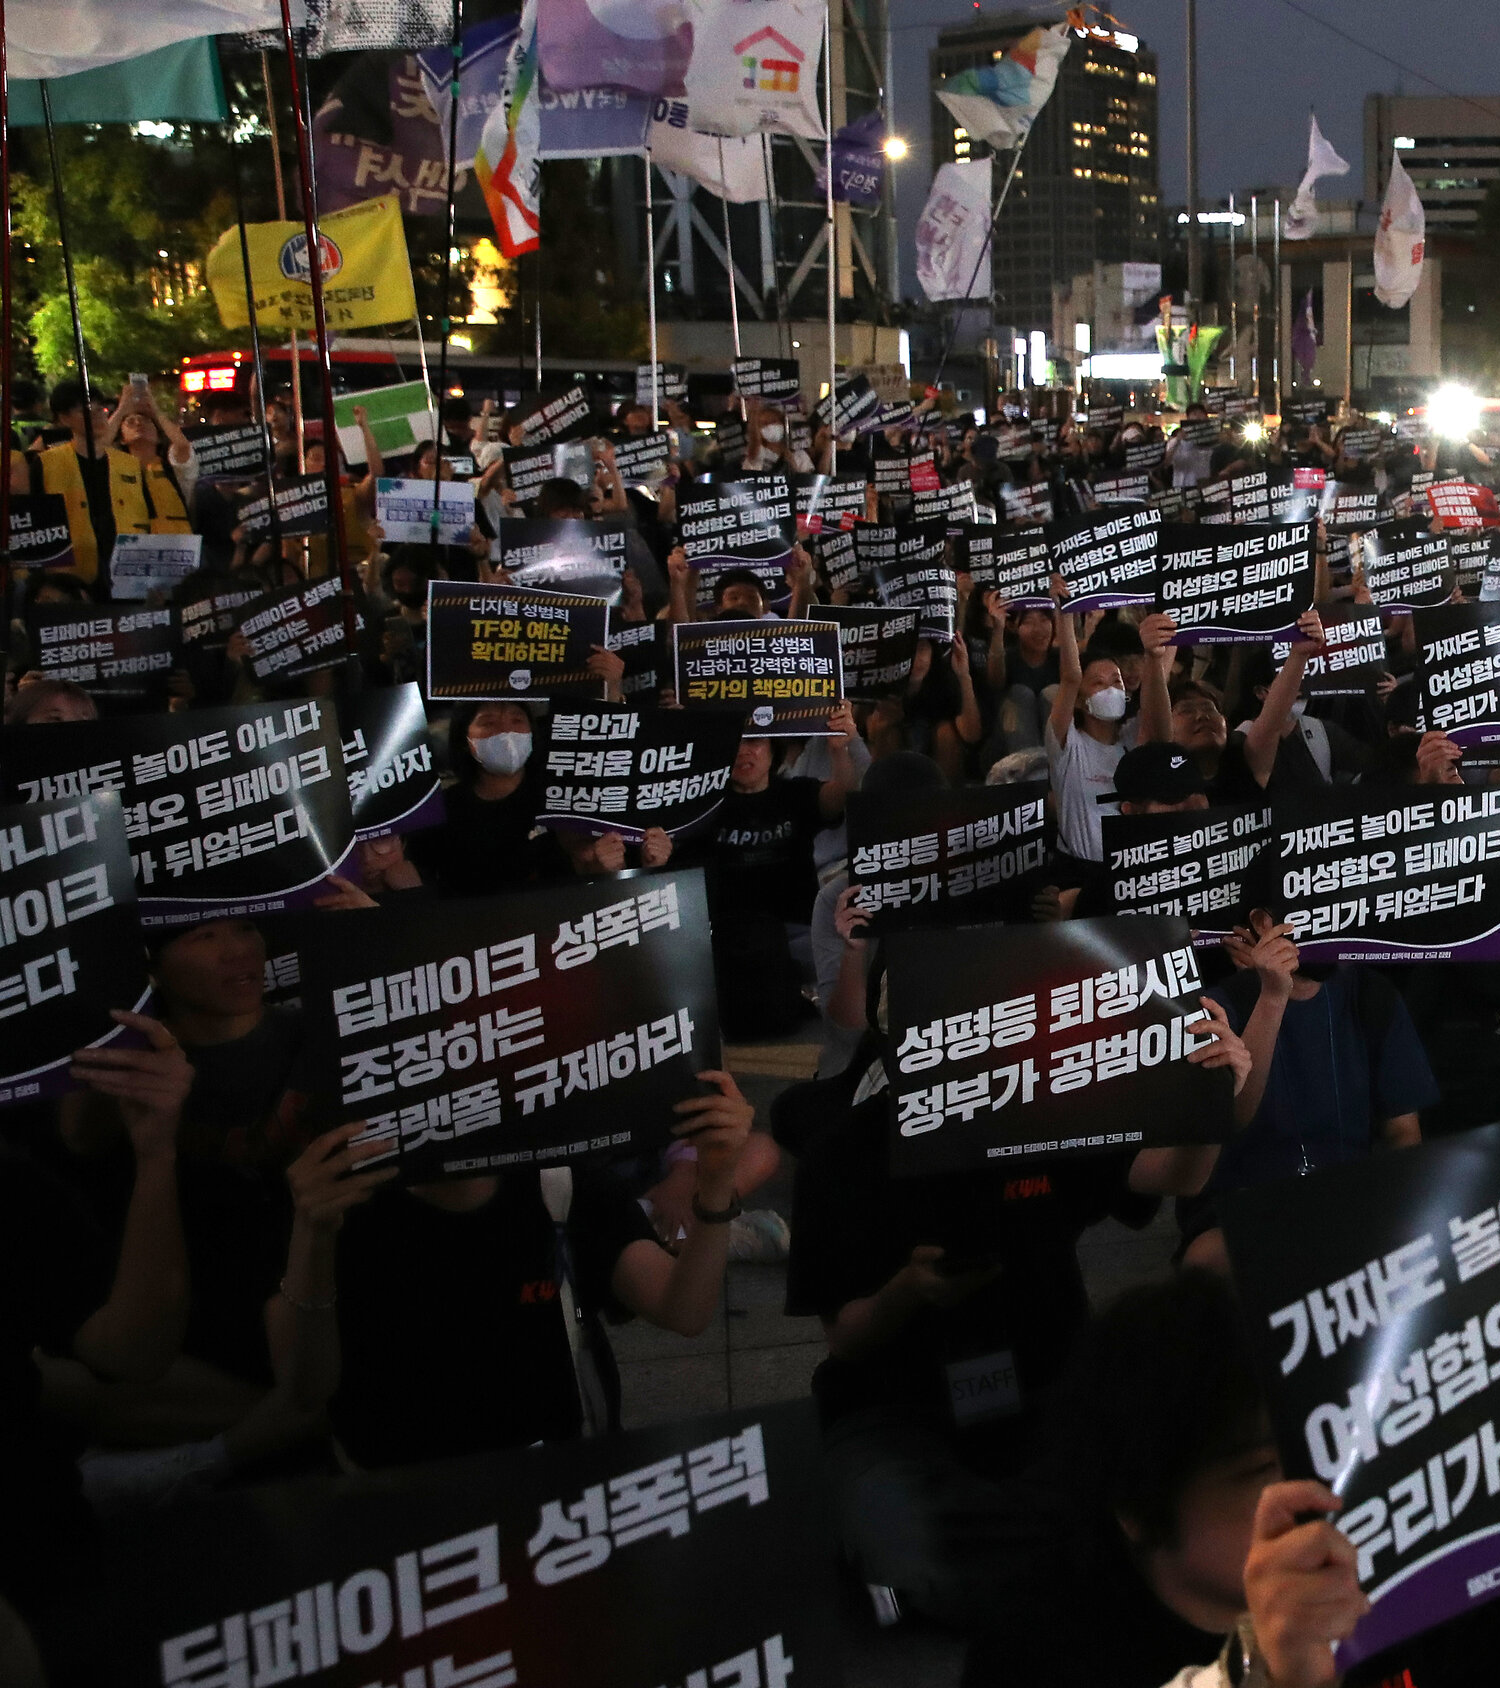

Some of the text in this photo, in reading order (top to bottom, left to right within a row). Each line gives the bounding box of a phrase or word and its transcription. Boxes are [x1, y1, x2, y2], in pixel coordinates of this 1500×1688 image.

[680, 486, 789, 517] 가짜도 놀이도 아니다
[682, 504, 791, 537] 여성혐오 딥페이크
[684, 528, 781, 557] 우리가 뒤엎는다
[1162, 524, 1310, 572] 가짜도 놀이도 아니다
[1162, 550, 1310, 601] 여성혐오 딥페이크
[469, 599, 569, 622] 디지털 성범죄
[1164, 585, 1294, 625] 우리가 뒤엎는다
[471, 642, 565, 663] 확대하라!
[472, 620, 571, 641] TF와 예산
[705, 637, 814, 656] 딥페이크 성범죄
[1423, 629, 1480, 664] 가짜도
[686, 656, 833, 677] 긴급하고 강력한 해결!
[687, 677, 836, 699] 국가의 책임이다!
[551, 711, 641, 741] 불안과
[1432, 689, 1498, 729] 우리가
[132, 730, 231, 785] 놀이도
[236, 700, 322, 754] 아니다
[545, 743, 695, 780] 두려움 아닌
[1171, 755, 1183, 763] NIKE
[196, 745, 332, 821] 딥페이크
[544, 766, 735, 814] 일상을 쟁취하자
[165, 804, 312, 879] 뒤엎는다
[852, 798, 1046, 876] 성평등 퇴행시킨
[1110, 821, 1229, 872] 가짜도 놀이도
[1279, 817, 1358, 860] 가짜도
[1359, 801, 1439, 840] 놀이도
[853, 839, 1047, 914] 정부가 공범이다
[1113, 855, 1203, 902] 여성혐오
[1280, 852, 1397, 901] 여성혐오
[1283, 874, 1487, 941] 우리가 뒤엎는다
[332, 882, 684, 1038] 딥페이크 성폭력
[896, 944, 1204, 1075] 성평등 퇴행시킨
[339, 1003, 546, 1107] 조장하는
[513, 1006, 697, 1116] 규제하라
[896, 1005, 1220, 1139] 정부가 공범이다
[1267, 1231, 1446, 1377] 가짜도
[951, 1367, 1013, 1401] STAFF
[160, 1422, 772, 1688] 딥페이크 성폭력
